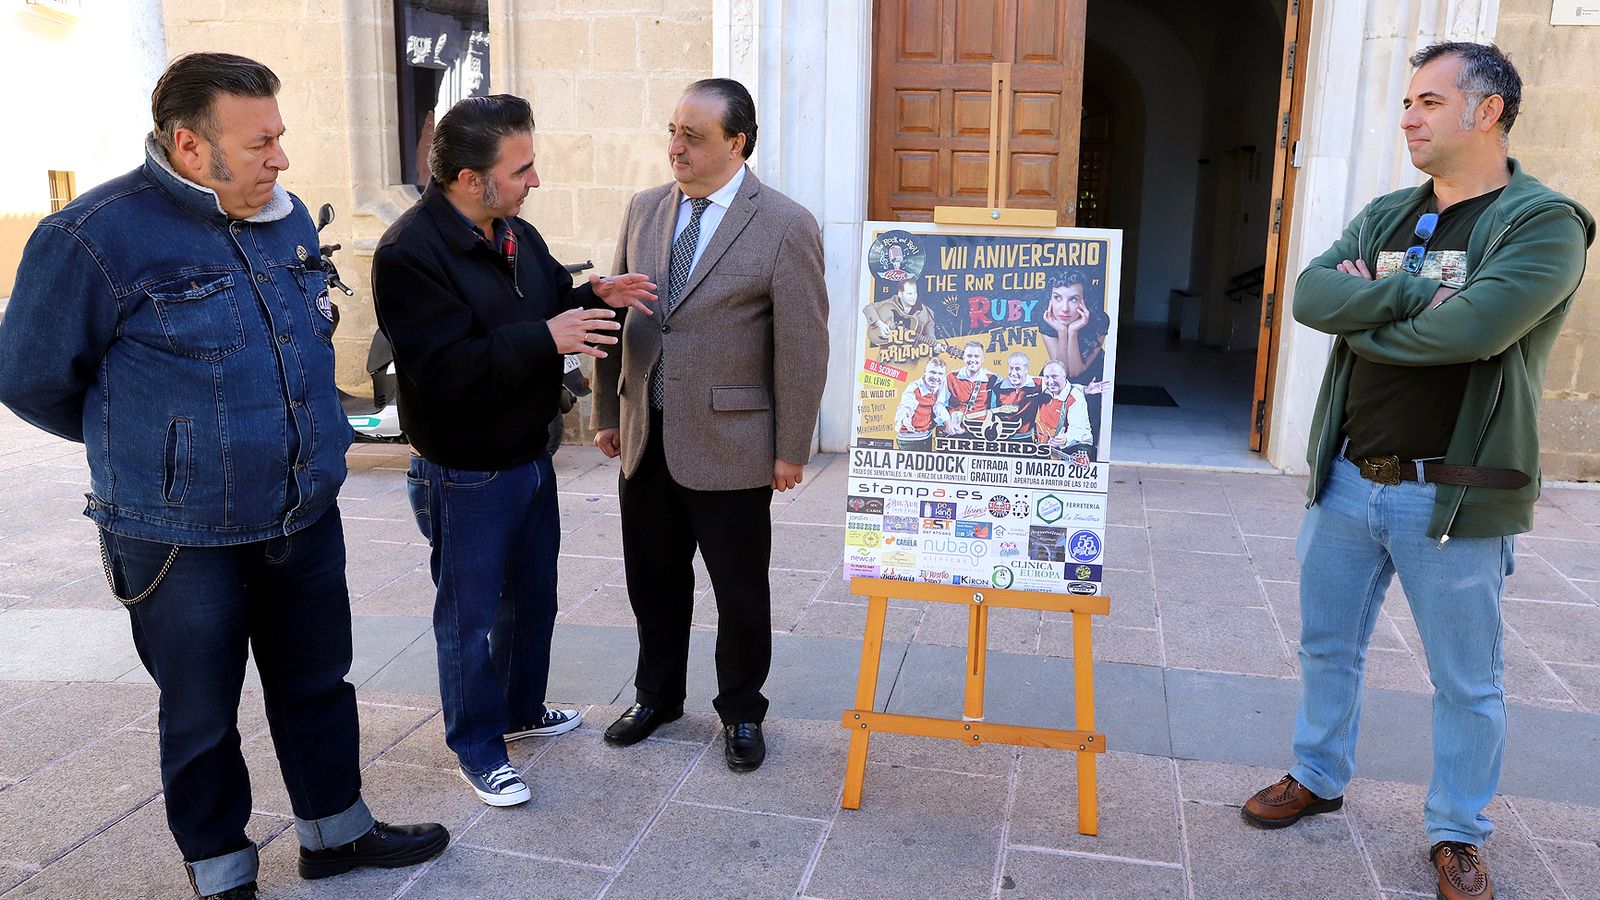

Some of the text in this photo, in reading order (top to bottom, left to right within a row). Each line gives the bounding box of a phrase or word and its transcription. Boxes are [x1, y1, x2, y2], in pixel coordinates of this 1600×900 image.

[974, 242, 1100, 269] ANIVERSARIO
[925, 274, 958, 292] THE
[1002, 272, 1046, 290] CLUB
[969, 296, 1038, 328] RUBY
[888, 322, 916, 344] RIC
[986, 326, 1039, 353] ANN
[879, 365, 900, 378] SCOOBY
[874, 377, 890, 387] LEWIS
[936, 439, 1051, 456] FIREBIRDS
[854, 450, 965, 473] SALA PADDOCK
[972, 459, 1008, 471] ENTRADA
[970, 472, 1008, 483] GRATUITA
[1015, 462, 1098, 479] 9 MARZO 2024
[1011, 560, 1053, 570] CLINICA
[1020, 569, 1060, 579] EUROPA
